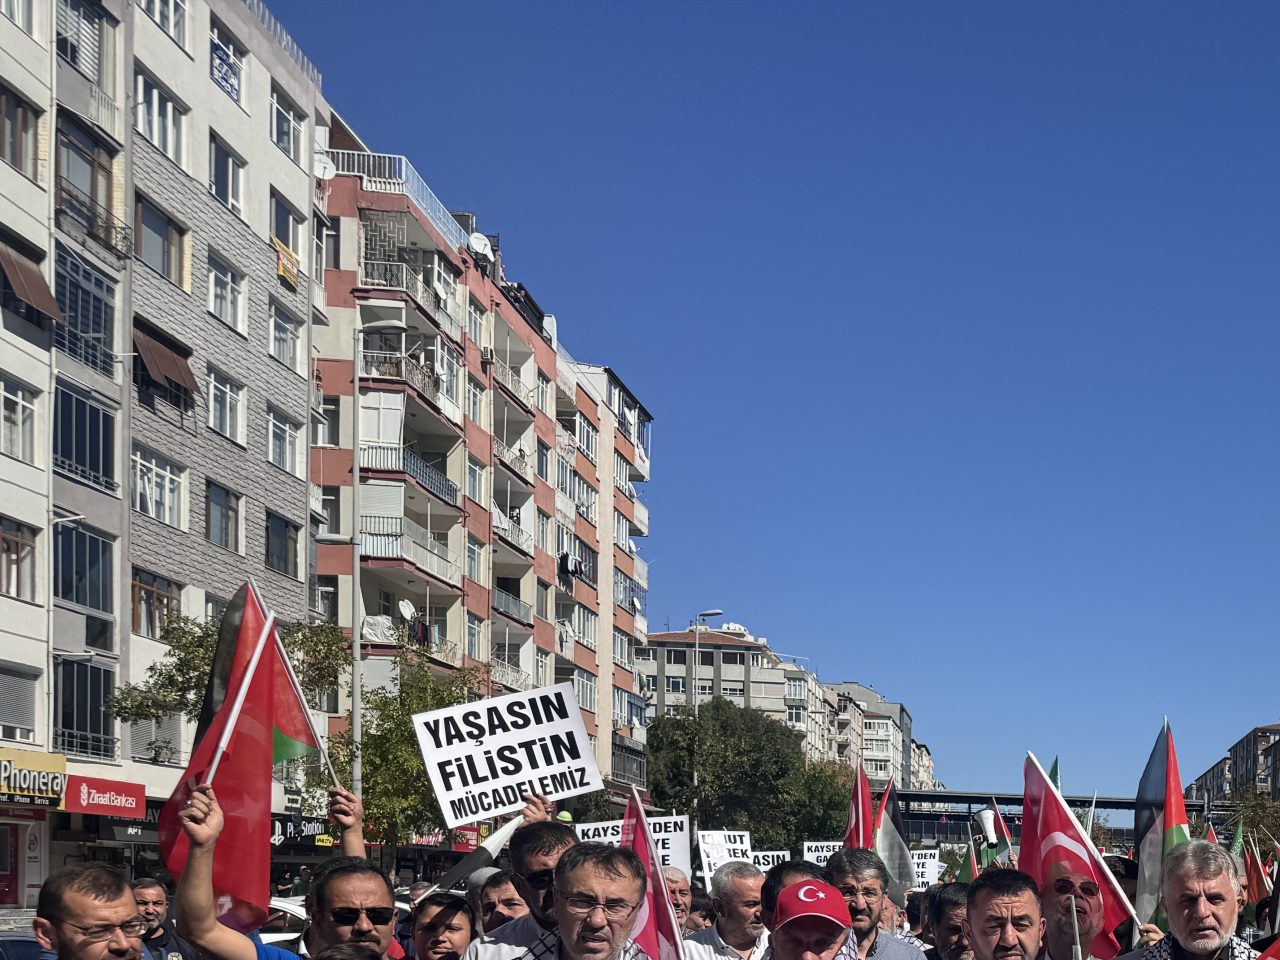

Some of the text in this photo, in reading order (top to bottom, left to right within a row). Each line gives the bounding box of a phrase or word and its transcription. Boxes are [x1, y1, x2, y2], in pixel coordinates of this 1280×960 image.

[423, 691, 570, 747] YAŞASIN
[0, 760, 68, 798] Phoneray
[89, 788, 136, 808] Ziraat Bankası
